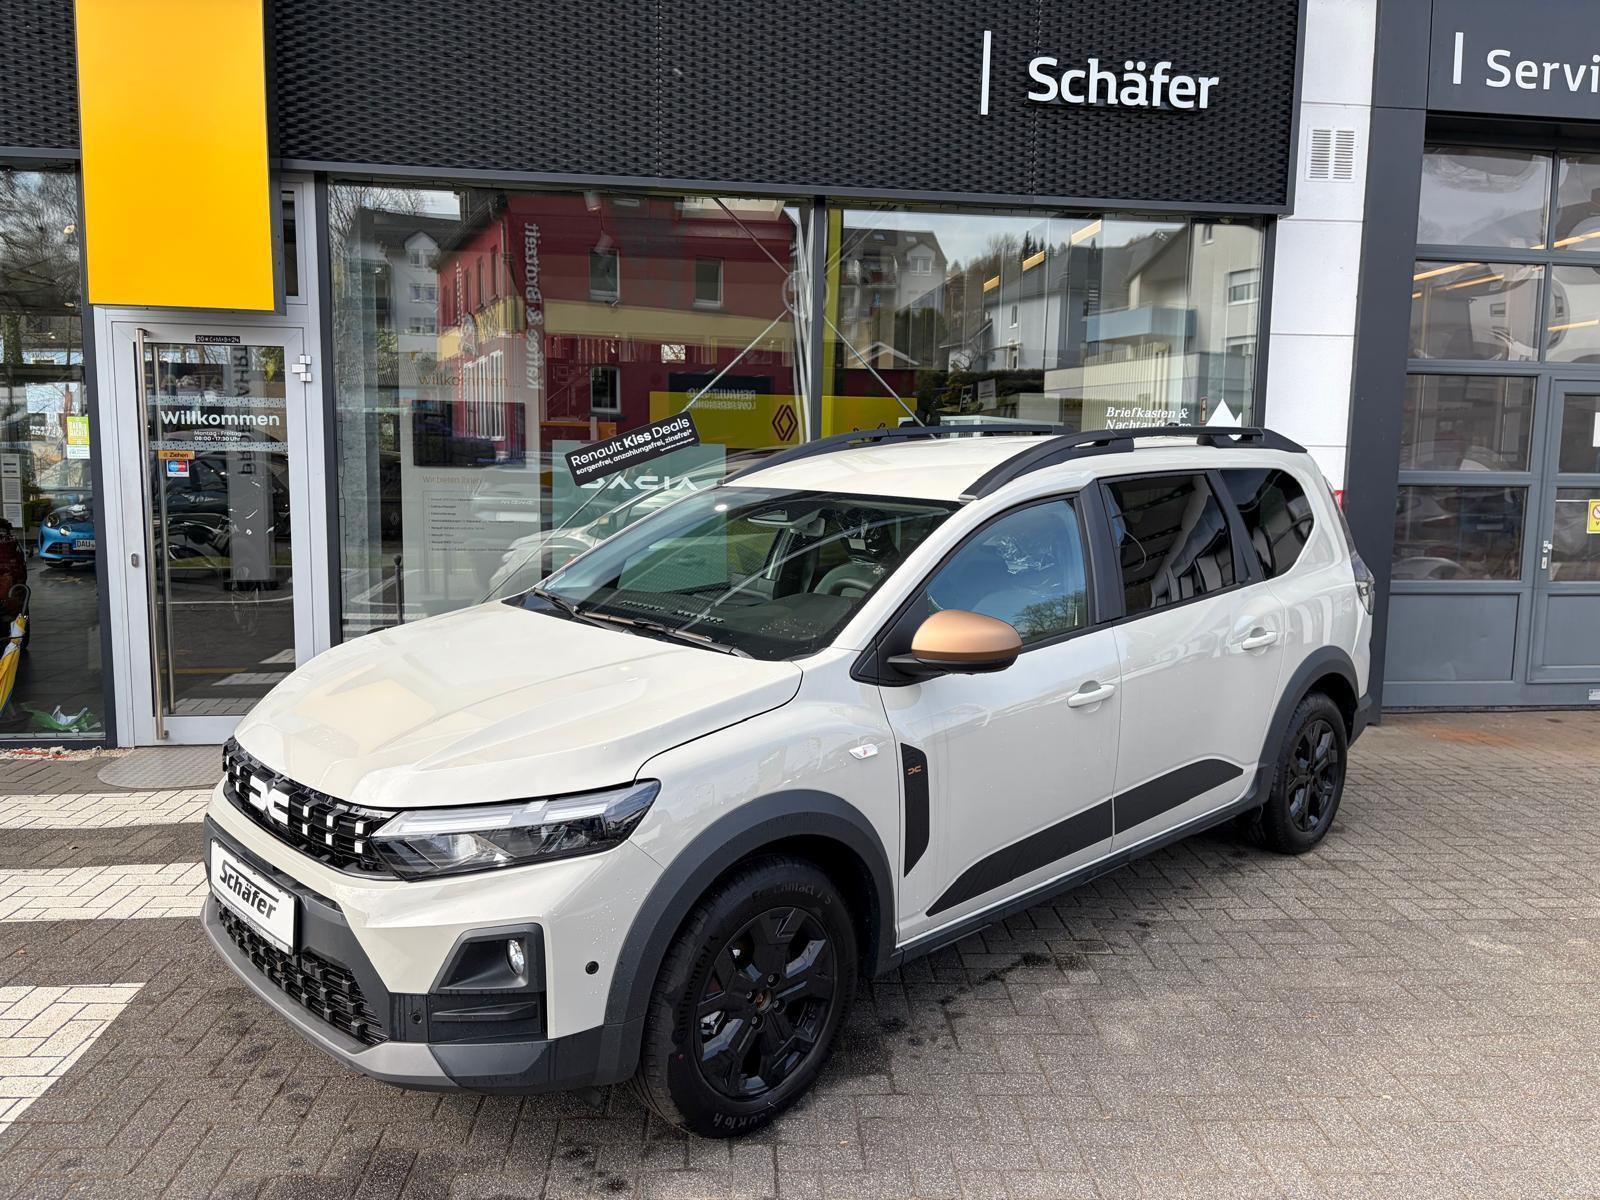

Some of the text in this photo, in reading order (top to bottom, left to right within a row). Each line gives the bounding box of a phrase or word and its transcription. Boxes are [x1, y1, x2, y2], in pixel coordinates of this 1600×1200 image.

[1028, 56, 1220, 109] Schäfer
[1485, 48, 1600, 93] Servi
[160, 410, 280, 426] Willkommen
[1105, 406, 1176, 419] Briefkasten
[1178, 408, 1190, 418] &
[571, 441, 624, 467] Renault
[623, 431, 652, 449] Kiss
[652, 418, 690, 439] Deals
[576, 457, 614, 475] sorgenfrei,
[613, 438, 666, 462] anzahlungsfrei,
[219, 859, 280, 920] Schäfer
